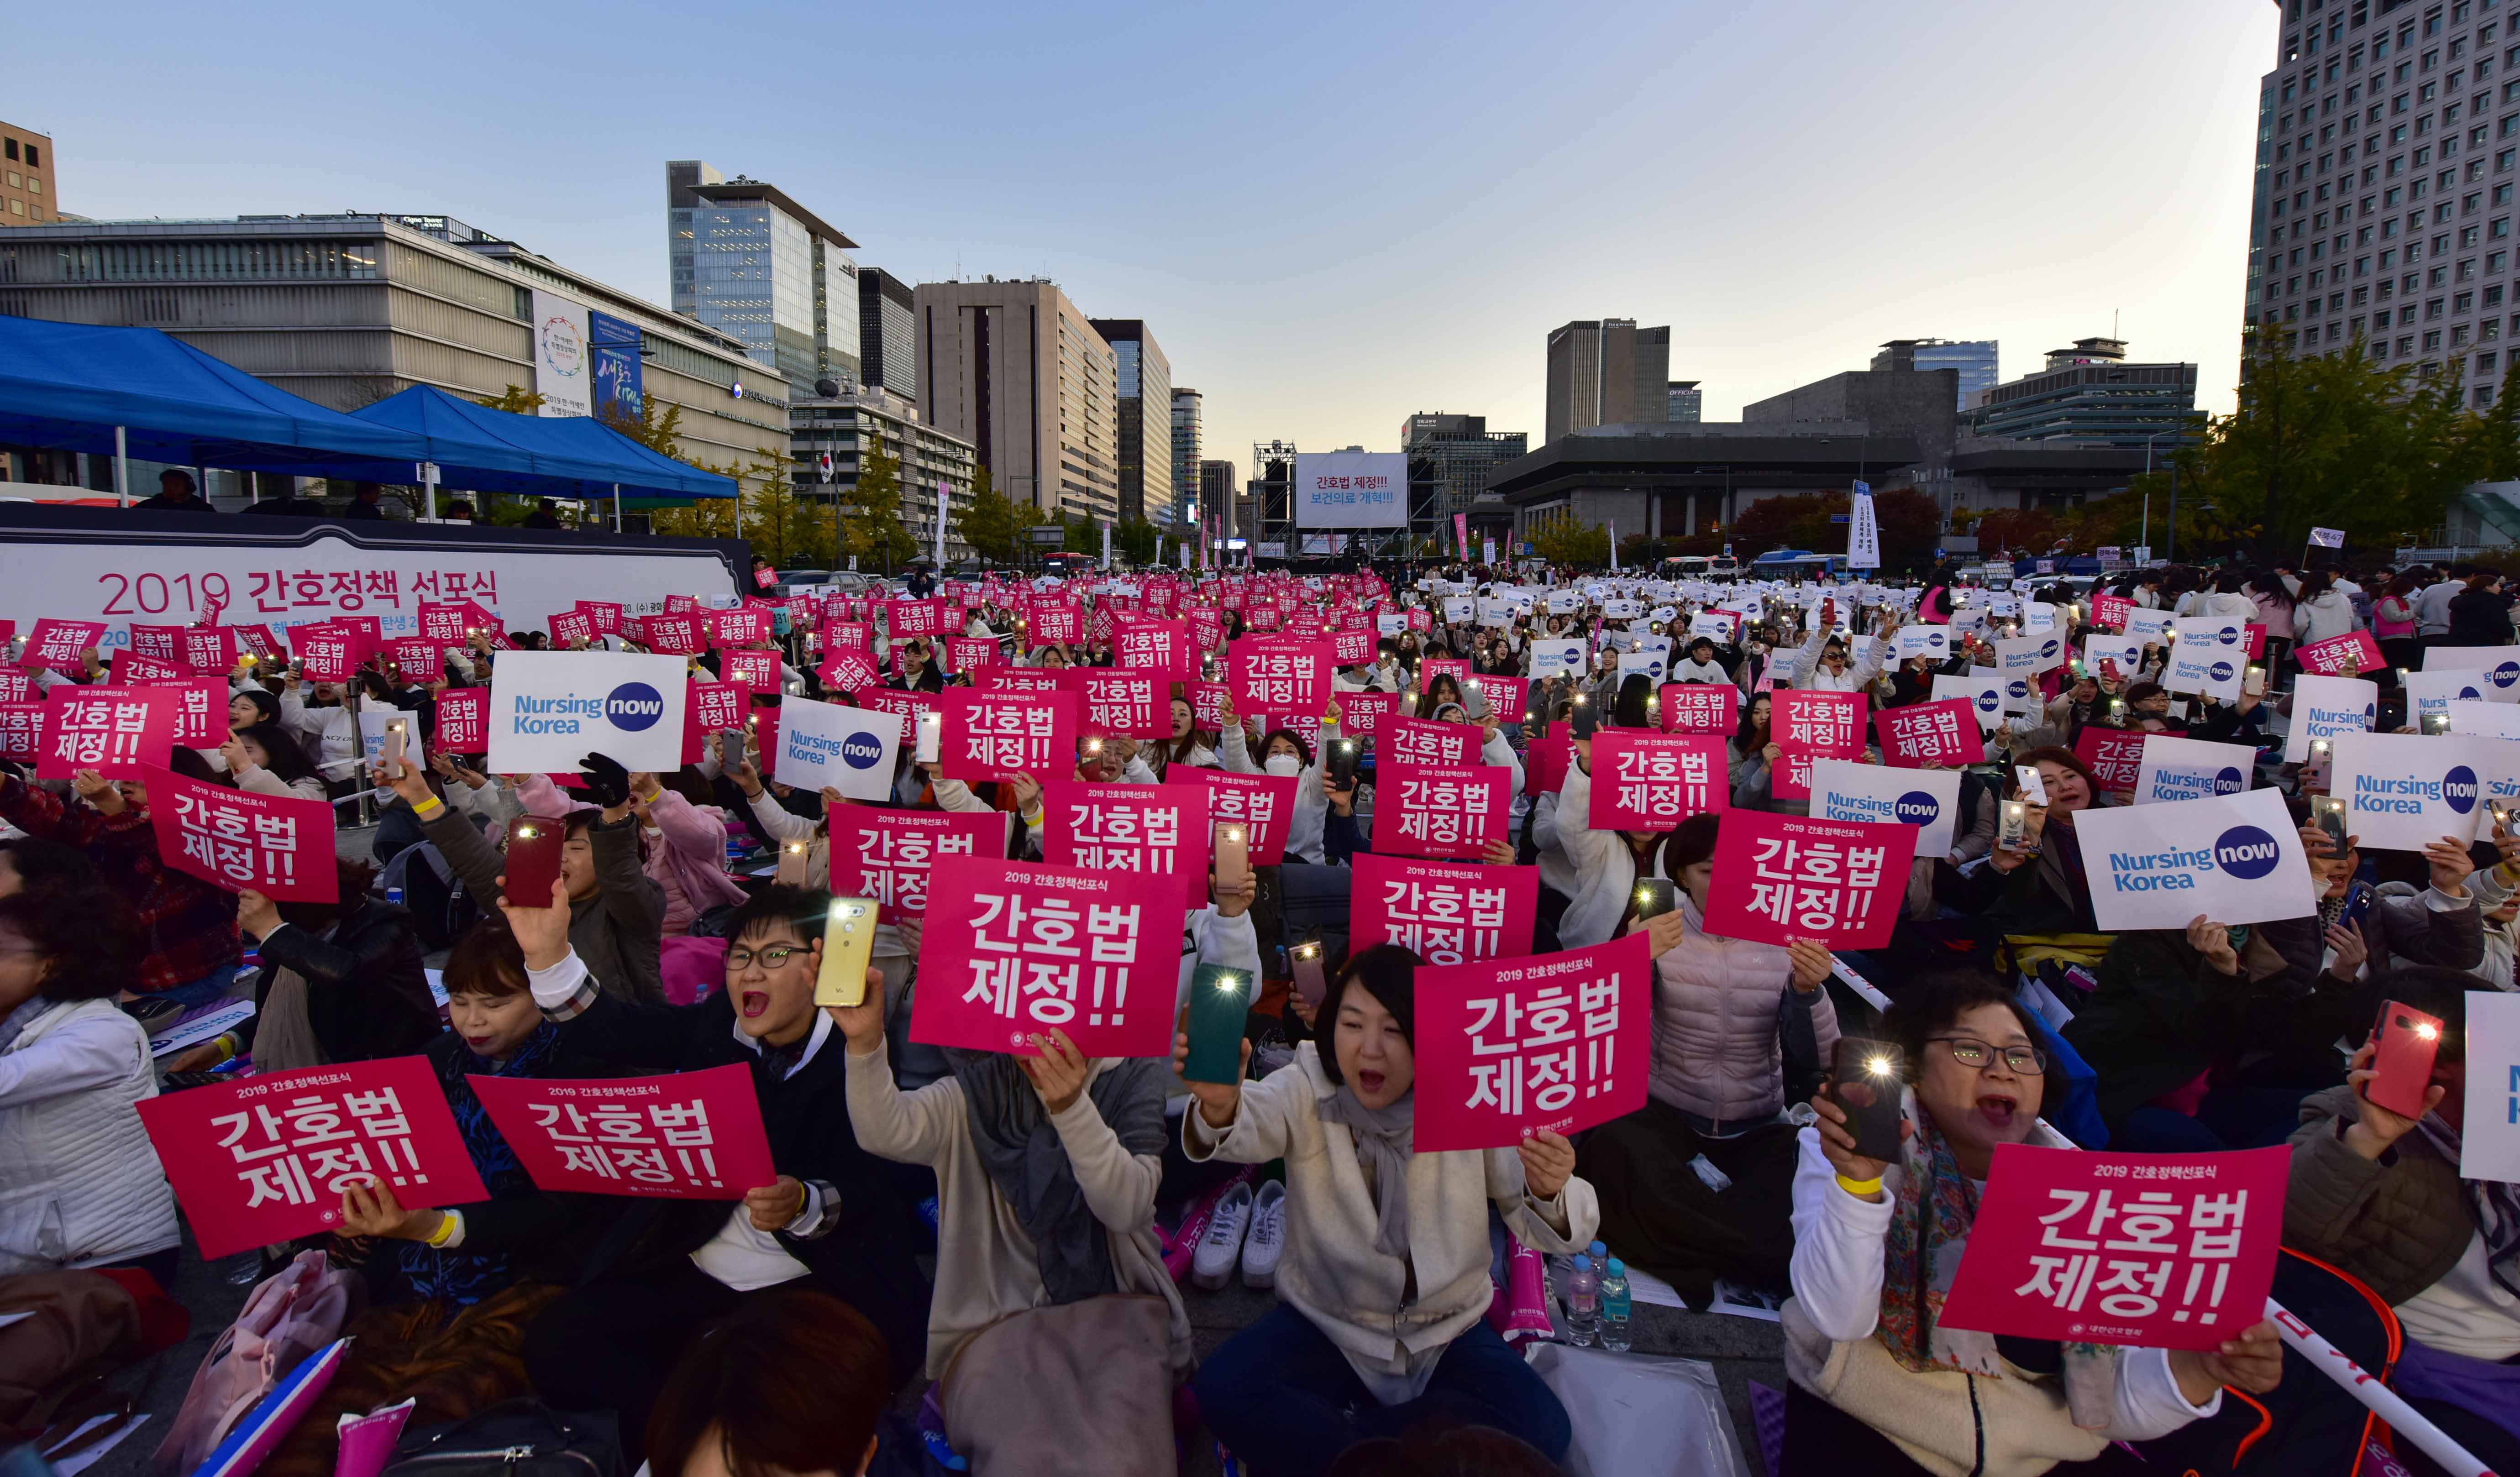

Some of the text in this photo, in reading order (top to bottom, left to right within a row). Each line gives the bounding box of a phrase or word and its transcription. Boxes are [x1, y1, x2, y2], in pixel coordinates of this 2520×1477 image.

[551, 341, 577, 353] 특별정상회의
[546, 394, 561, 404] 2019
[1317, 476, 1387, 489] 간호법 제정!!!
[1311, 491, 1393, 505] 보건의료 개혁!!!
[758, 569, 774, 581] 간호법
[1367, 580, 1381, 590] 간호법
[98, 569, 497, 615] 2019 간호정책 선포식
[964, 595, 979, 603] 간호법
[636, 602, 648, 613] (수)
[827, 602, 845, 612] 간호법
[897, 604, 934, 619] 간호법
[1279, 598, 1297, 608] 간호법
[2100, 600, 2132, 615] 간호법
[425, 612, 463, 626] 간호법
[719, 614, 756, 628] 간호법
[1039, 613, 1073, 626] 간호법
[1254, 611, 1275, 620] 간호법
[1254, 616, 1274, 626] 제정!!
[1413, 611, 1429, 622] 간호법
[1413, 616, 1429, 630] 제정!!
[45, 628, 91, 644] 간호법
[651, 620, 692, 636] 간호법
[720, 626, 755, 640] 제정!!
[305, 641, 345, 659] 간호법
[955, 644, 989, 657] 간호법
[1335, 634, 1368, 654] 간호법
[2308, 641, 2362, 664] 간호법
[731, 657, 770, 672] 간호법
[1245, 655, 1314, 679] 간호법
[1538, 653, 1564, 661] Nursing
[2175, 669, 2200, 680] Korea
[2178, 661, 2210, 675] Nursing
[2211, 667, 2233, 676] now
[2494, 670, 2519, 680] now
[1087, 680, 1152, 703] 간호법
[1246, 679, 1312, 704] 제정!!
[1675, 693, 1724, 710] 간호법
[441, 699, 477, 721] 간호법
[514, 693, 604, 719] Nursing
[609, 699, 661, 715] now
[1089, 704, 1151, 728] 제정!!
[1789, 701, 1853, 724] 간호법
[60, 701, 148, 733] 간호법
[514, 716, 580, 734] Korea
[965, 705, 1054, 734] 간호법
[1675, 710, 1723, 727] 제정!!
[1891, 708, 1958, 738] 간호법
[2309, 708, 2364, 728] Nursing
[441, 721, 478, 743] 제정!!
[1789, 723, 1851, 746] 제정!!
[54, 732, 139, 764] 제정!!
[789, 729, 841, 757] Nursing
[845, 743, 881, 758] now
[966, 736, 1050, 768] 제정!!
[1896, 731, 1962, 758] 제정!!
[788, 744, 825, 766] Korea
[1617, 751, 1708, 783] 간호법
[2155, 770, 2214, 792] Nursing
[2216, 779, 2241, 792] now
[2355, 775, 2441, 801] Nursing
[2446, 782, 2477, 797] now
[211, 790, 267, 808] 간호정책선포식
[1400, 780, 1489, 813] 간호법
[1616, 784, 1706, 816] 제정!!
[1827, 791, 1894, 816] Nursing
[2354, 794, 2422, 815] Korea
[1898, 803, 1937, 816] now
[174, 793, 297, 852] 간호법
[1069, 804, 1178, 846] 간호법
[1398, 812, 1485, 845] 제정!!
[1783, 823, 1864, 838] 2019 간호정책선포식
[181, 832, 296, 886] 제정!!
[1752, 838, 1885, 887] 간호법
[2109, 846, 2215, 871] Nursing
[2219, 842, 2275, 863] now
[1005, 871, 1108, 892] 2019 간호정책선포식
[1407, 866, 1482, 880] 2019 간호정책선포식
[2114, 873, 2195, 891] Korea
[1383, 880, 1506, 927] 간호법
[1745, 883, 1873, 930] 제정!!
[969, 893, 1140, 963] 간호법
[1496, 956, 1593, 983] 2019 간호정책선포식
[962, 958, 1129, 1026] 제정!!
[1463, 972, 1620, 1057] 간호법
[236, 1072, 352, 1099] 2019 간호정책선포식
[1465, 1035, 1614, 1116] 제정!!
[548, 1084, 660, 1097] 2019 간호정책선포식
[210, 1086, 412, 1163] 간호법
[528, 1099, 714, 1146] 간호법
[237, 1137, 429, 1209] 제정!!
[554, 1145, 724, 1188] 제정!!
[2094, 1164, 2217, 1180] 2019 간호정책선포식
[2038, 1189, 2248, 1258] 간호법
[2015, 1255, 2230, 1325] 제정!!
[2089, 1325, 2142, 1336] 대한간호협회
